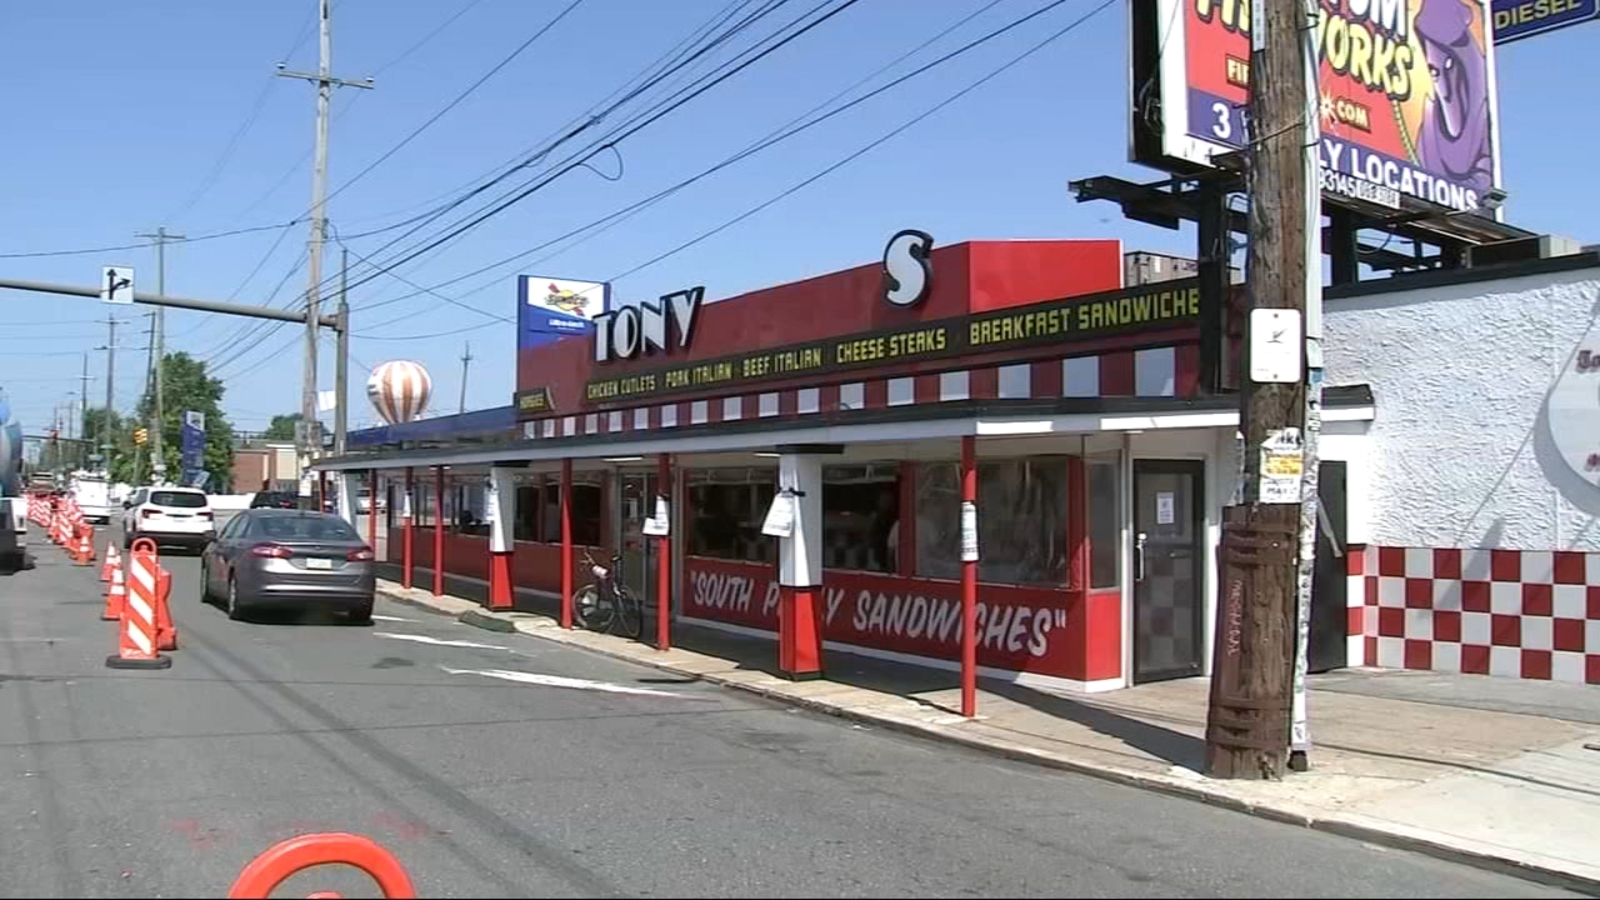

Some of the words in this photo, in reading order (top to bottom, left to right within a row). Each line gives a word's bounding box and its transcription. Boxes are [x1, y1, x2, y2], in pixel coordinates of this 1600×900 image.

[1494, 0, 1582, 30] DIESEL
[1336, 101, 1369, 128] COM
[1212, 102, 1231, 139] 3
[1351, 148, 1478, 210] LOCATIONS
[592, 286, 705, 362] TONY
[883, 229, 934, 308] S
[970, 308, 1071, 345] BREAKFAST
[1079, 287, 1199, 330] SANDWICHE
[588, 380, 619, 399] CHICKEN
[621, 375, 656, 394] CUTLETS
[666, 369, 690, 388] PORK
[692, 362, 732, 385] ITALIAN
[743, 356, 770, 378] BEEF
[774, 347, 822, 373] ITALIAN
[836, 336, 886, 364] CHEESE
[890, 328, 946, 357] STEAKS
[690, 571, 755, 612] "SOUTH
